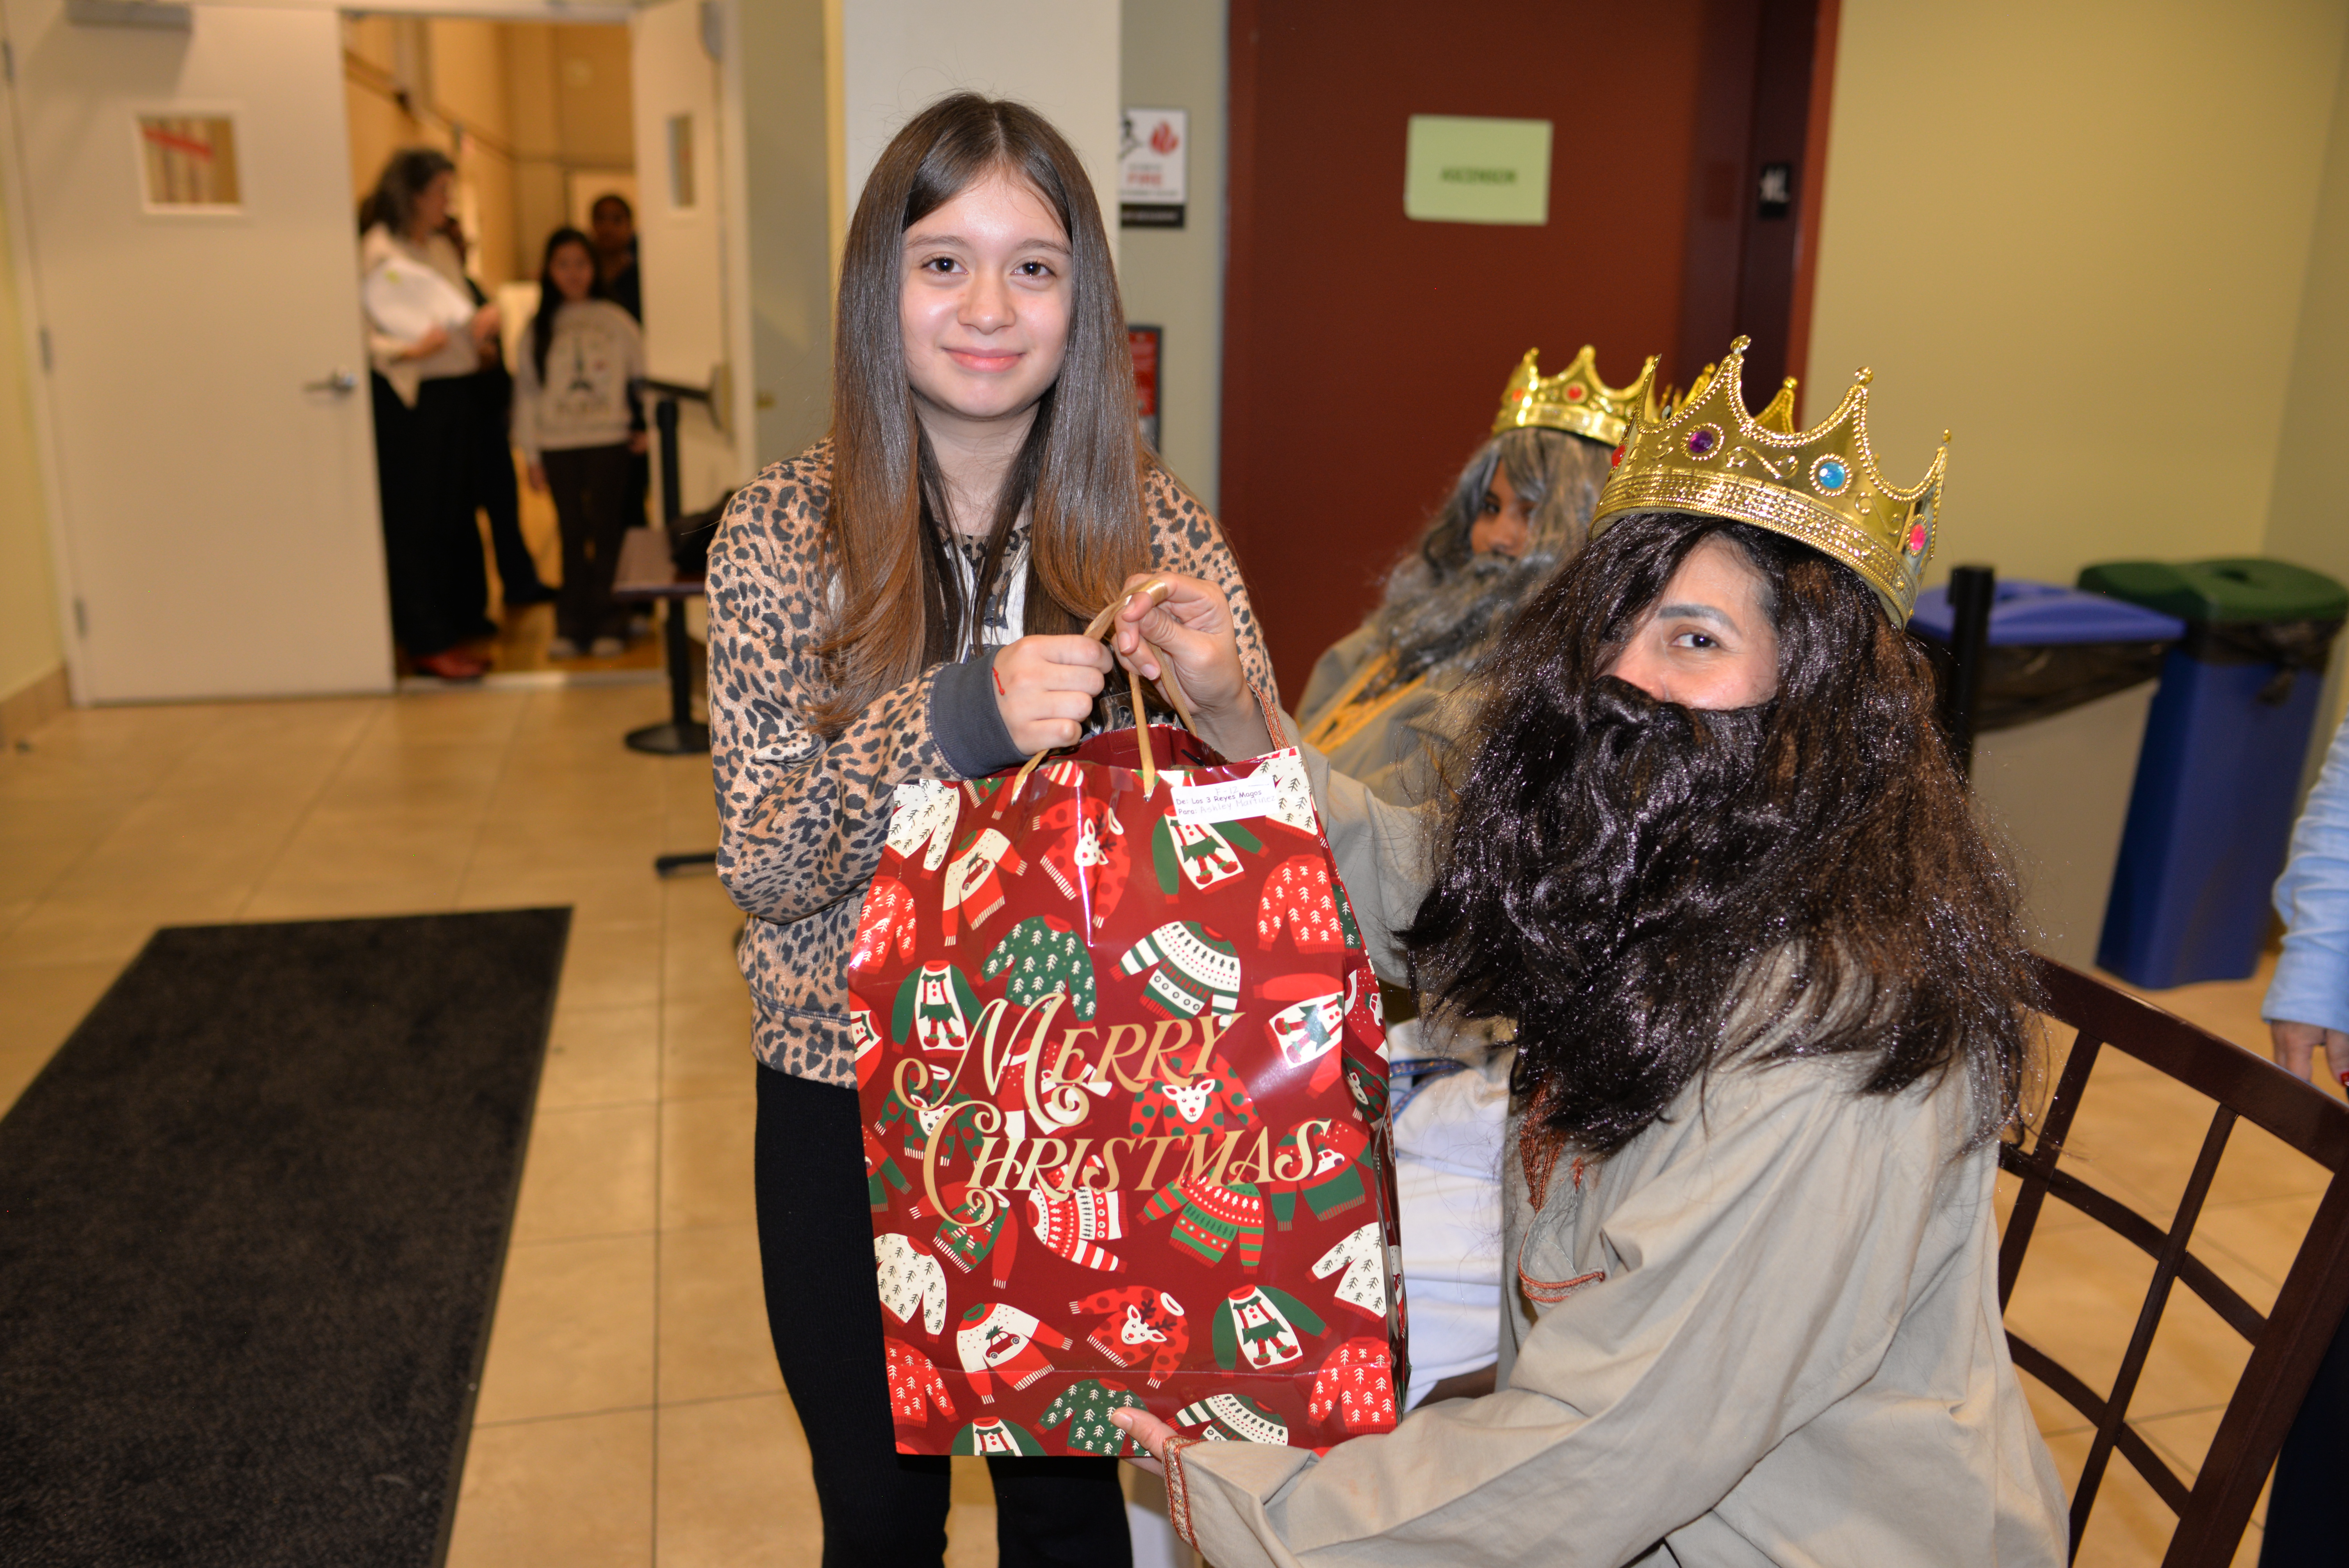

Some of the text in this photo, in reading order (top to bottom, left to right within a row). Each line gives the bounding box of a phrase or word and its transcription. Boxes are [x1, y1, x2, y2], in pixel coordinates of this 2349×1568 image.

[1127, 173, 1162, 185] FIRE
[1440, 167, 1517, 187] ASCENSOR
[1239, 790, 1262, 798] Magos
[1200, 802, 1232, 813] Ashley
[1236, 795, 1276, 807] Martinez
[893, 992, 1246, 1127] MERRY
[923, 1099, 1332, 1228] CHRISTMAS
